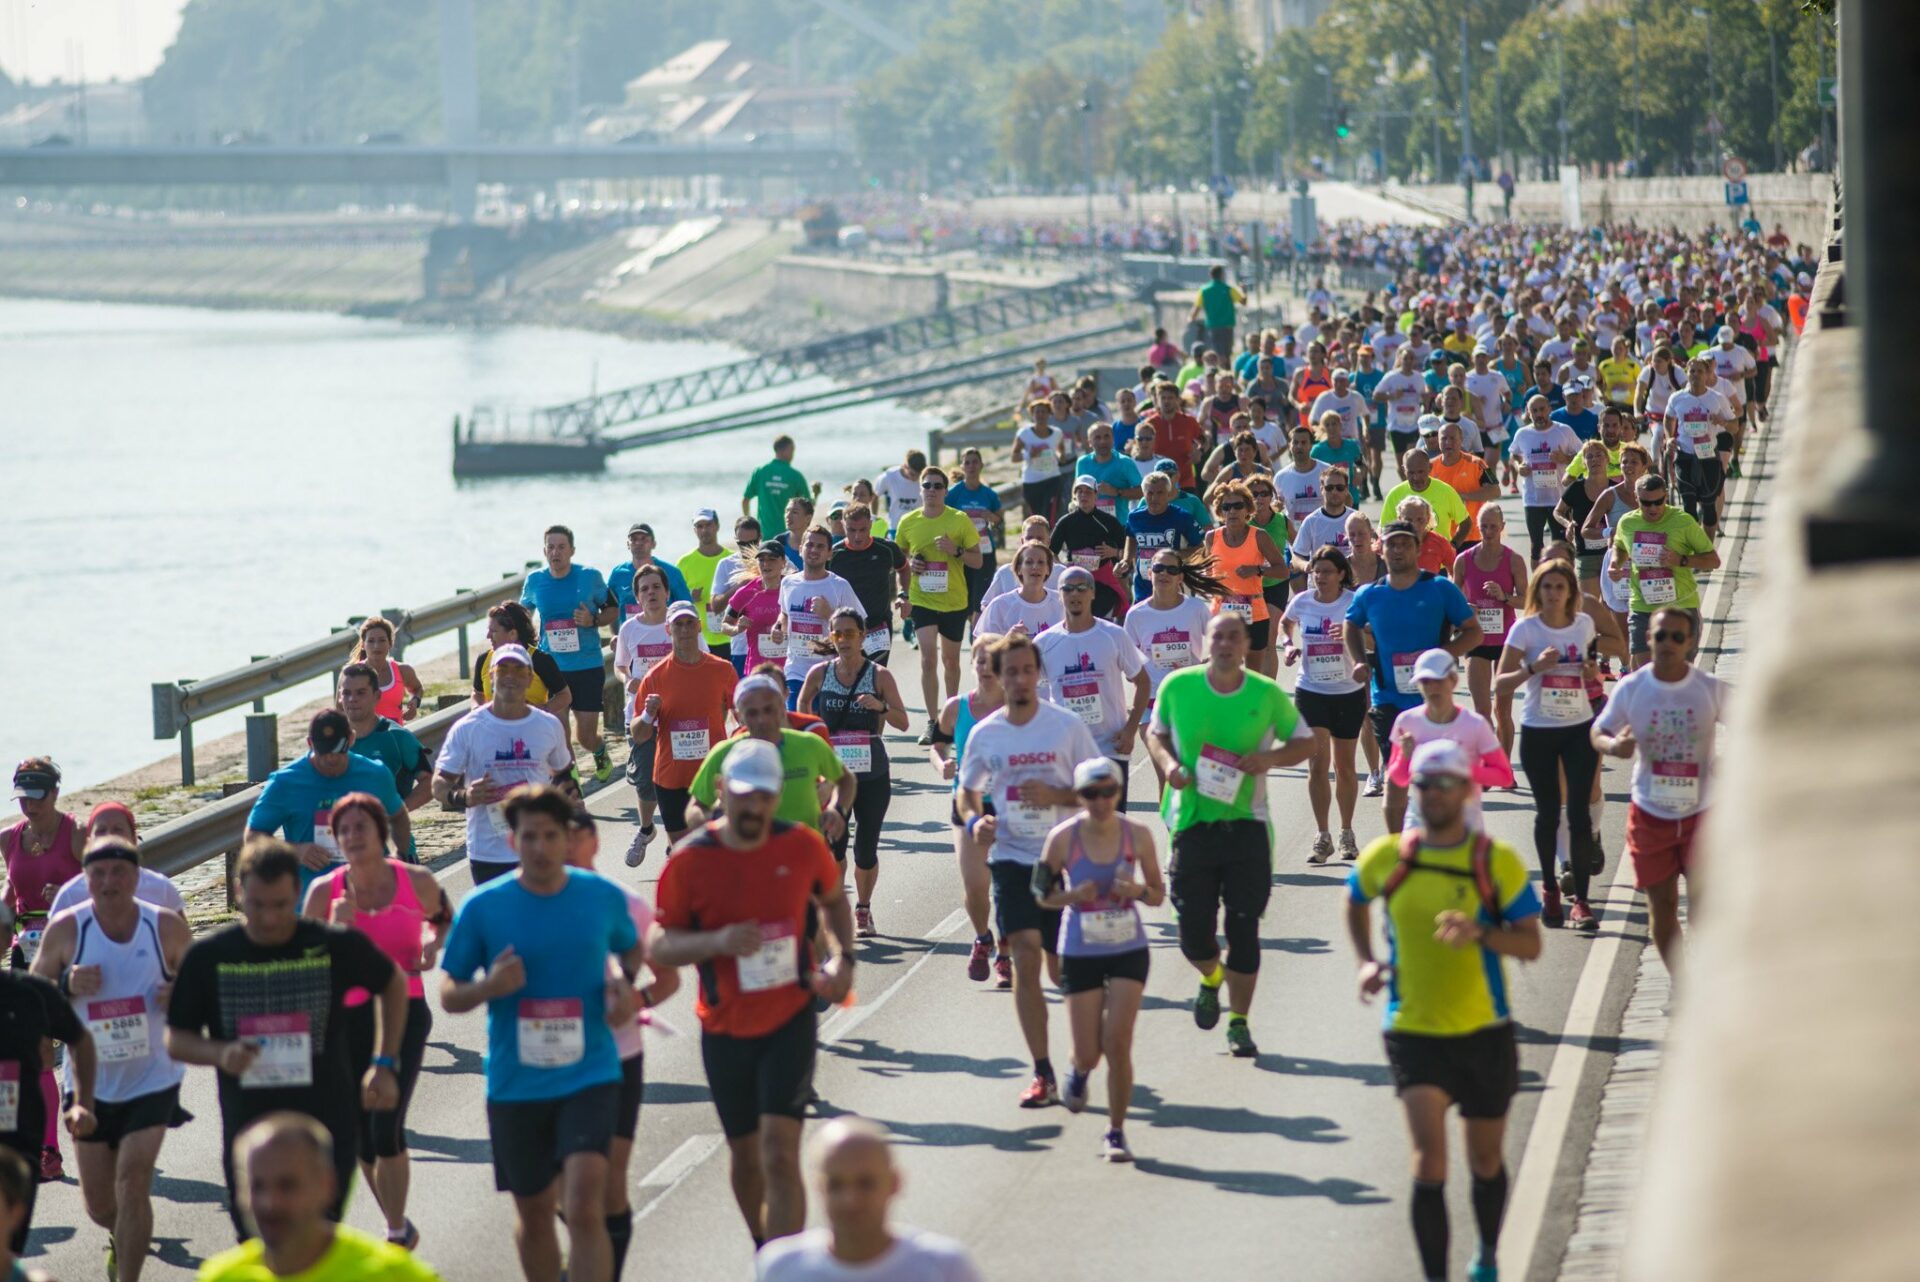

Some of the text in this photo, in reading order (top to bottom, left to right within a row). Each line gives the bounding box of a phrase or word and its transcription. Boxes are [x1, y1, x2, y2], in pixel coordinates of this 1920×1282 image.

[1166, 643, 1187, 651] 9030
[1076, 696, 1096, 705] 4169
[685, 731, 706, 740] 4287
[1008, 751, 1056, 767] BOSCH
